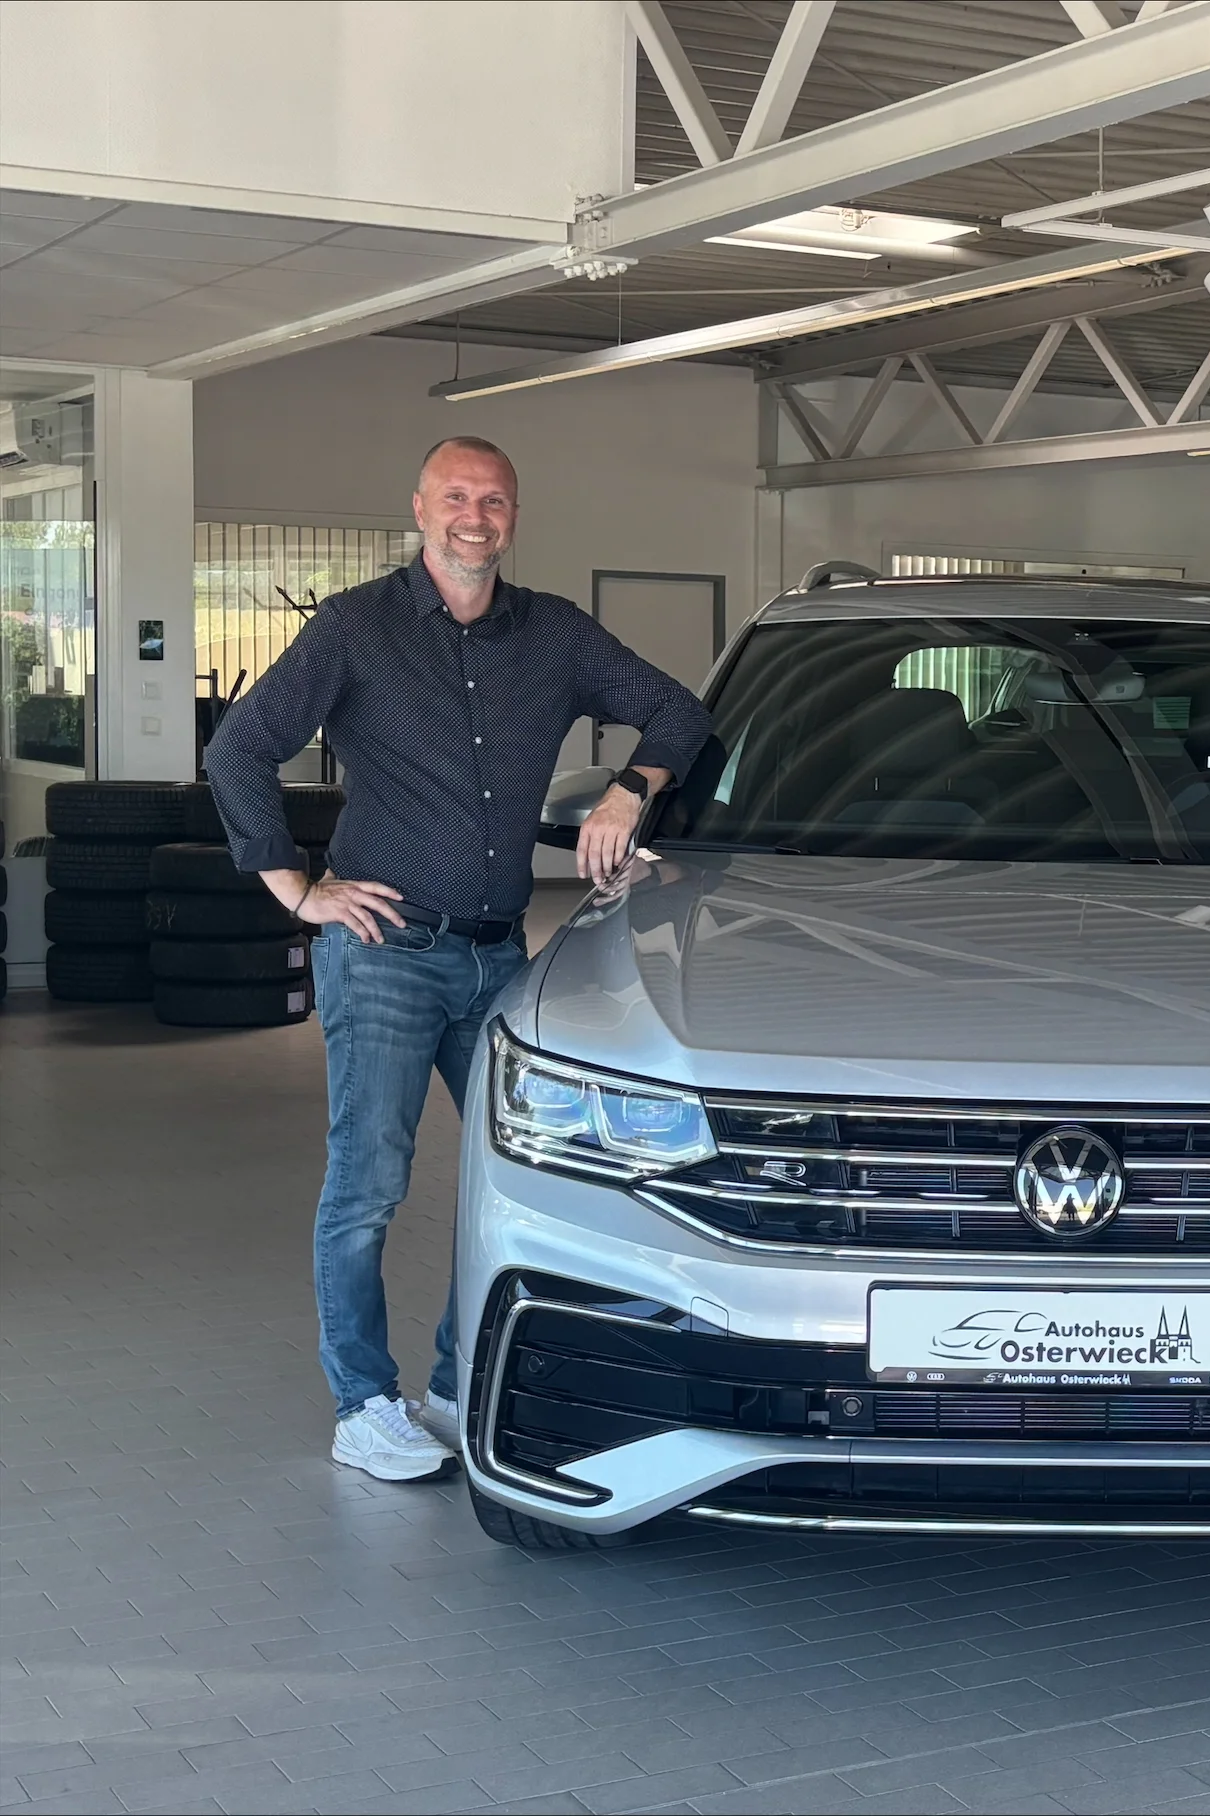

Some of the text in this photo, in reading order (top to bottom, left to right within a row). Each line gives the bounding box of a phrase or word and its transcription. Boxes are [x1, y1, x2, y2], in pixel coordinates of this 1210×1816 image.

[1044, 1320, 1145, 1338] Autohaus
[1000, 1339, 1168, 1364] Osterwieck
[1002, 1372, 1122, 1385] Autohaus Osterwieck
